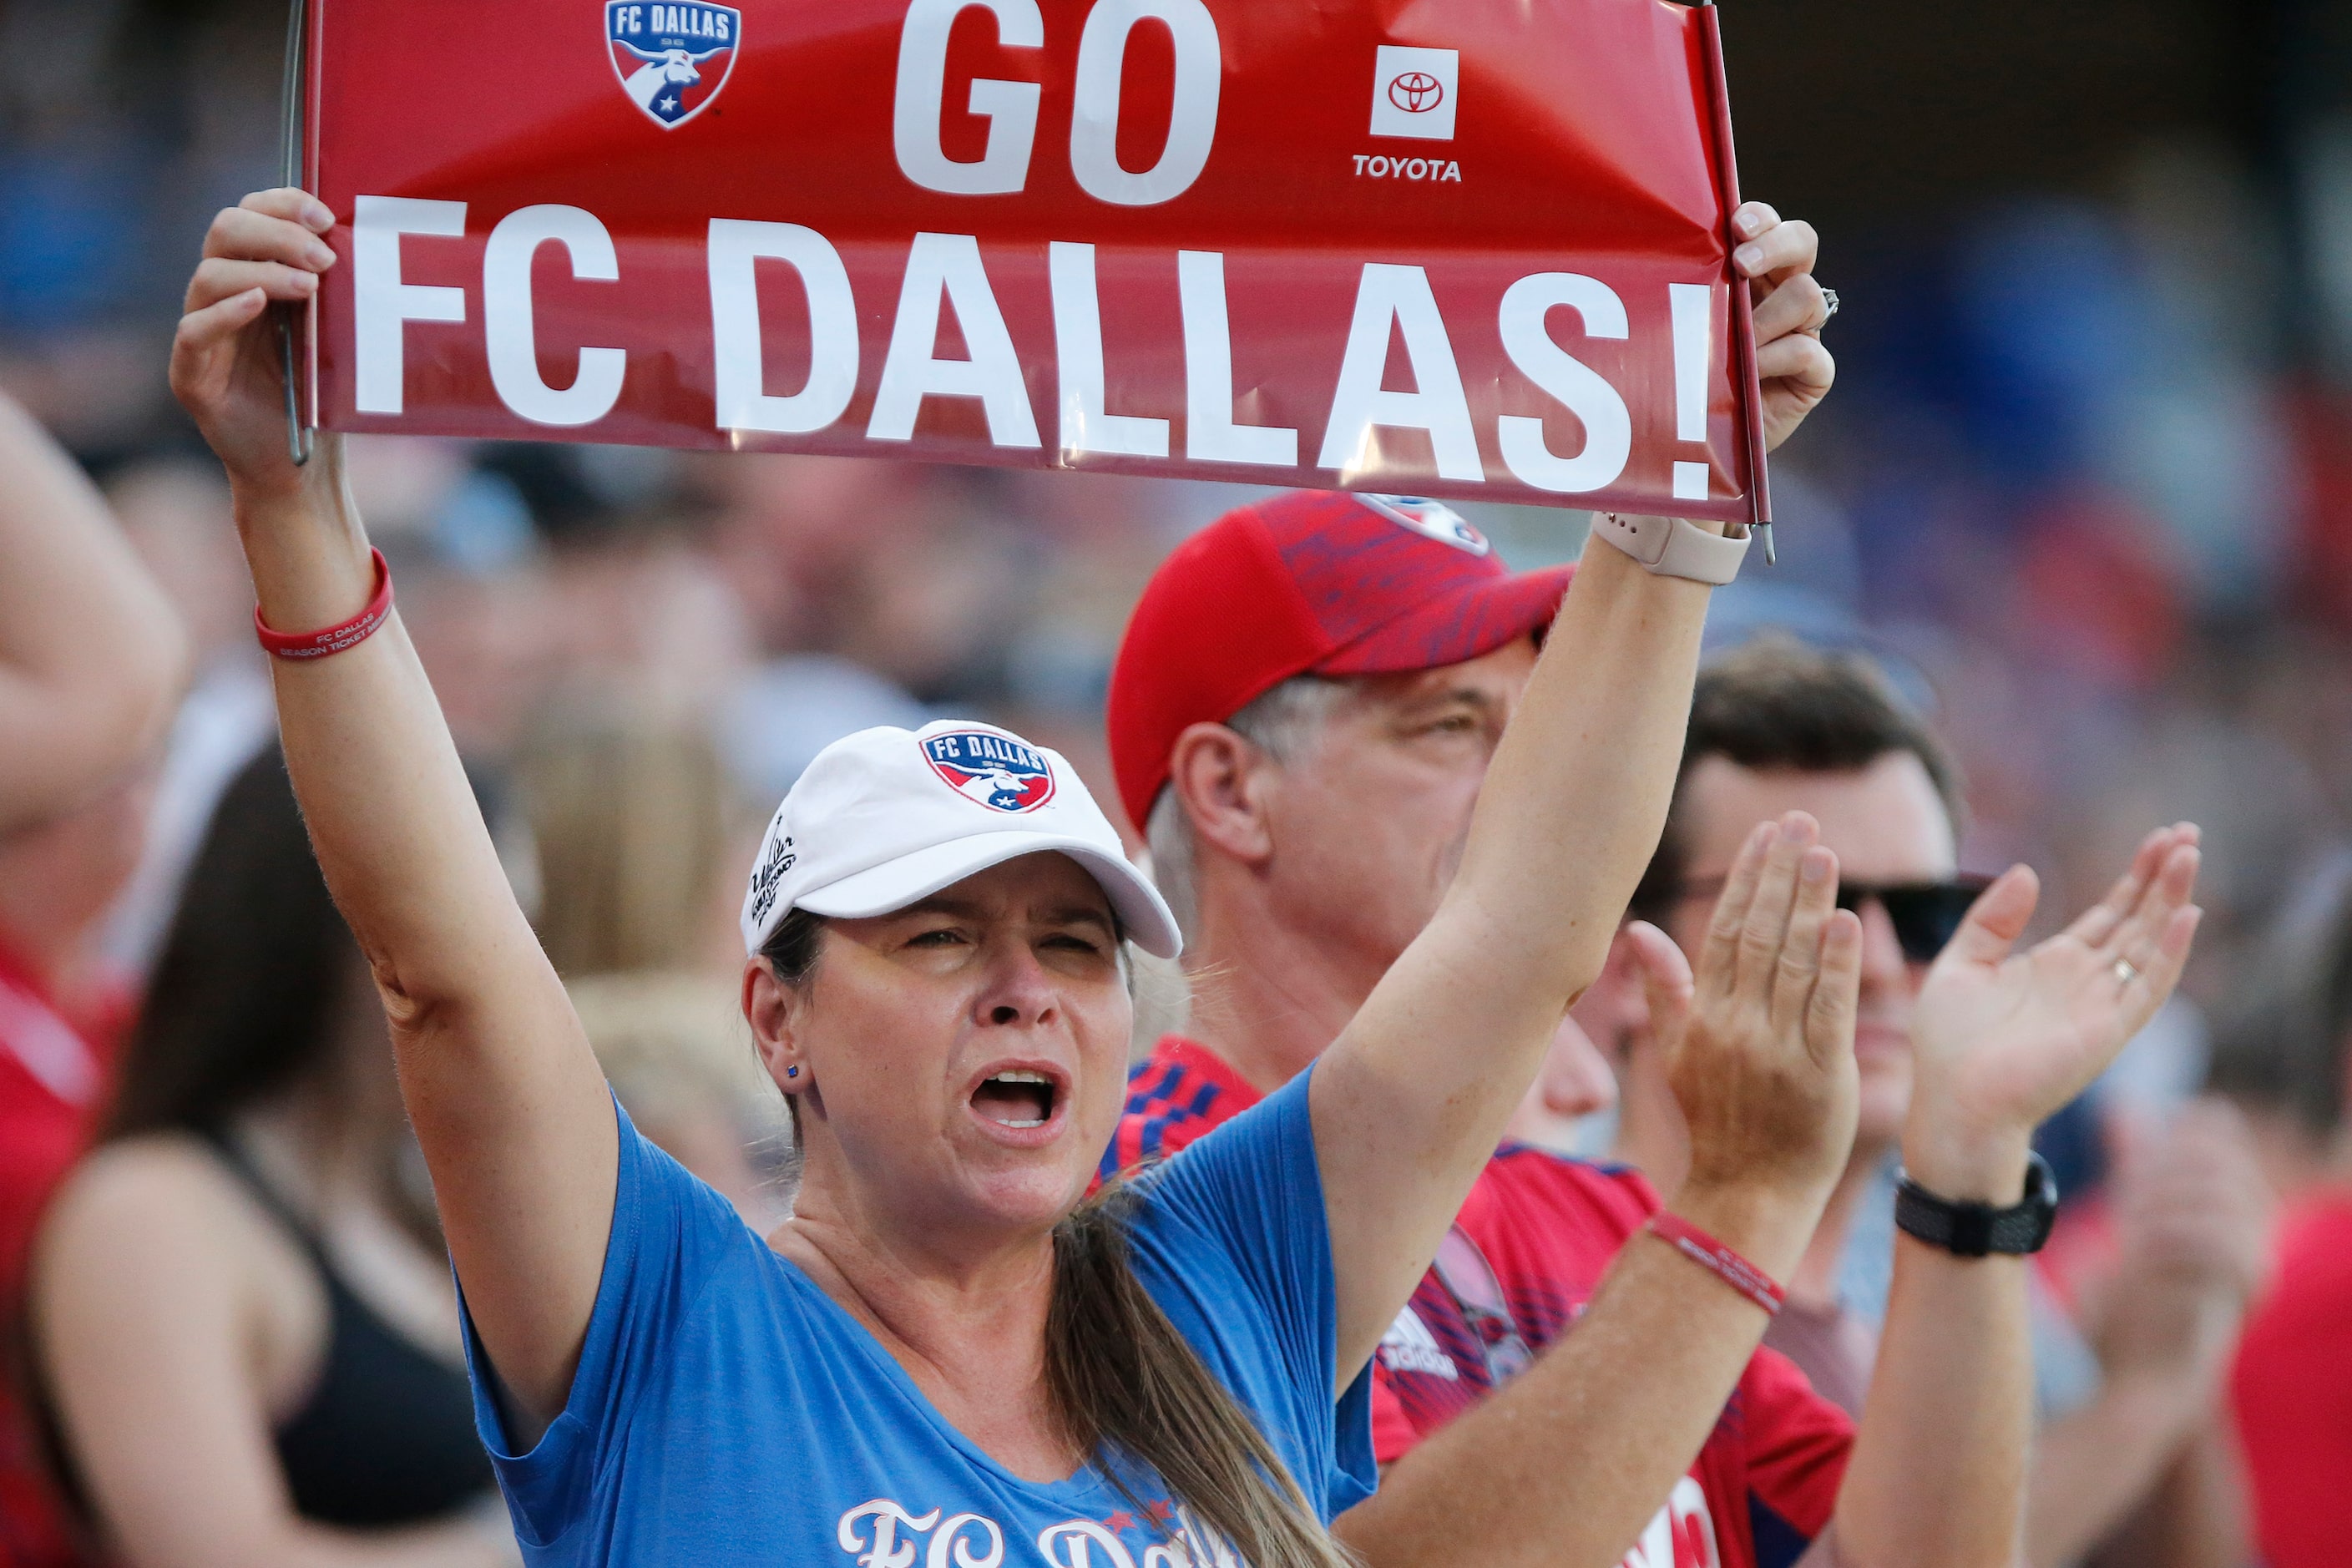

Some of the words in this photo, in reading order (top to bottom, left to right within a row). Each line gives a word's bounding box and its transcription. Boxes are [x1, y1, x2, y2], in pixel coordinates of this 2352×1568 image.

[617, 5, 642, 35] FC
[652, 4, 729, 39] DALLAS
[893, 0, 1222, 208] GO
[1353, 154, 1462, 182] TOYOTA
[353, 195, 627, 426] FC
[708, 217, 1710, 501] DALLAS!
[281, 646, 327, 656] SEASON
[330, 630, 367, 650] TICKET
[316, 633, 333, 645] FC
[335, 612, 375, 638] DALLAS
[933, 737, 960, 759] FC
[967, 736, 1043, 770] DALLAS
